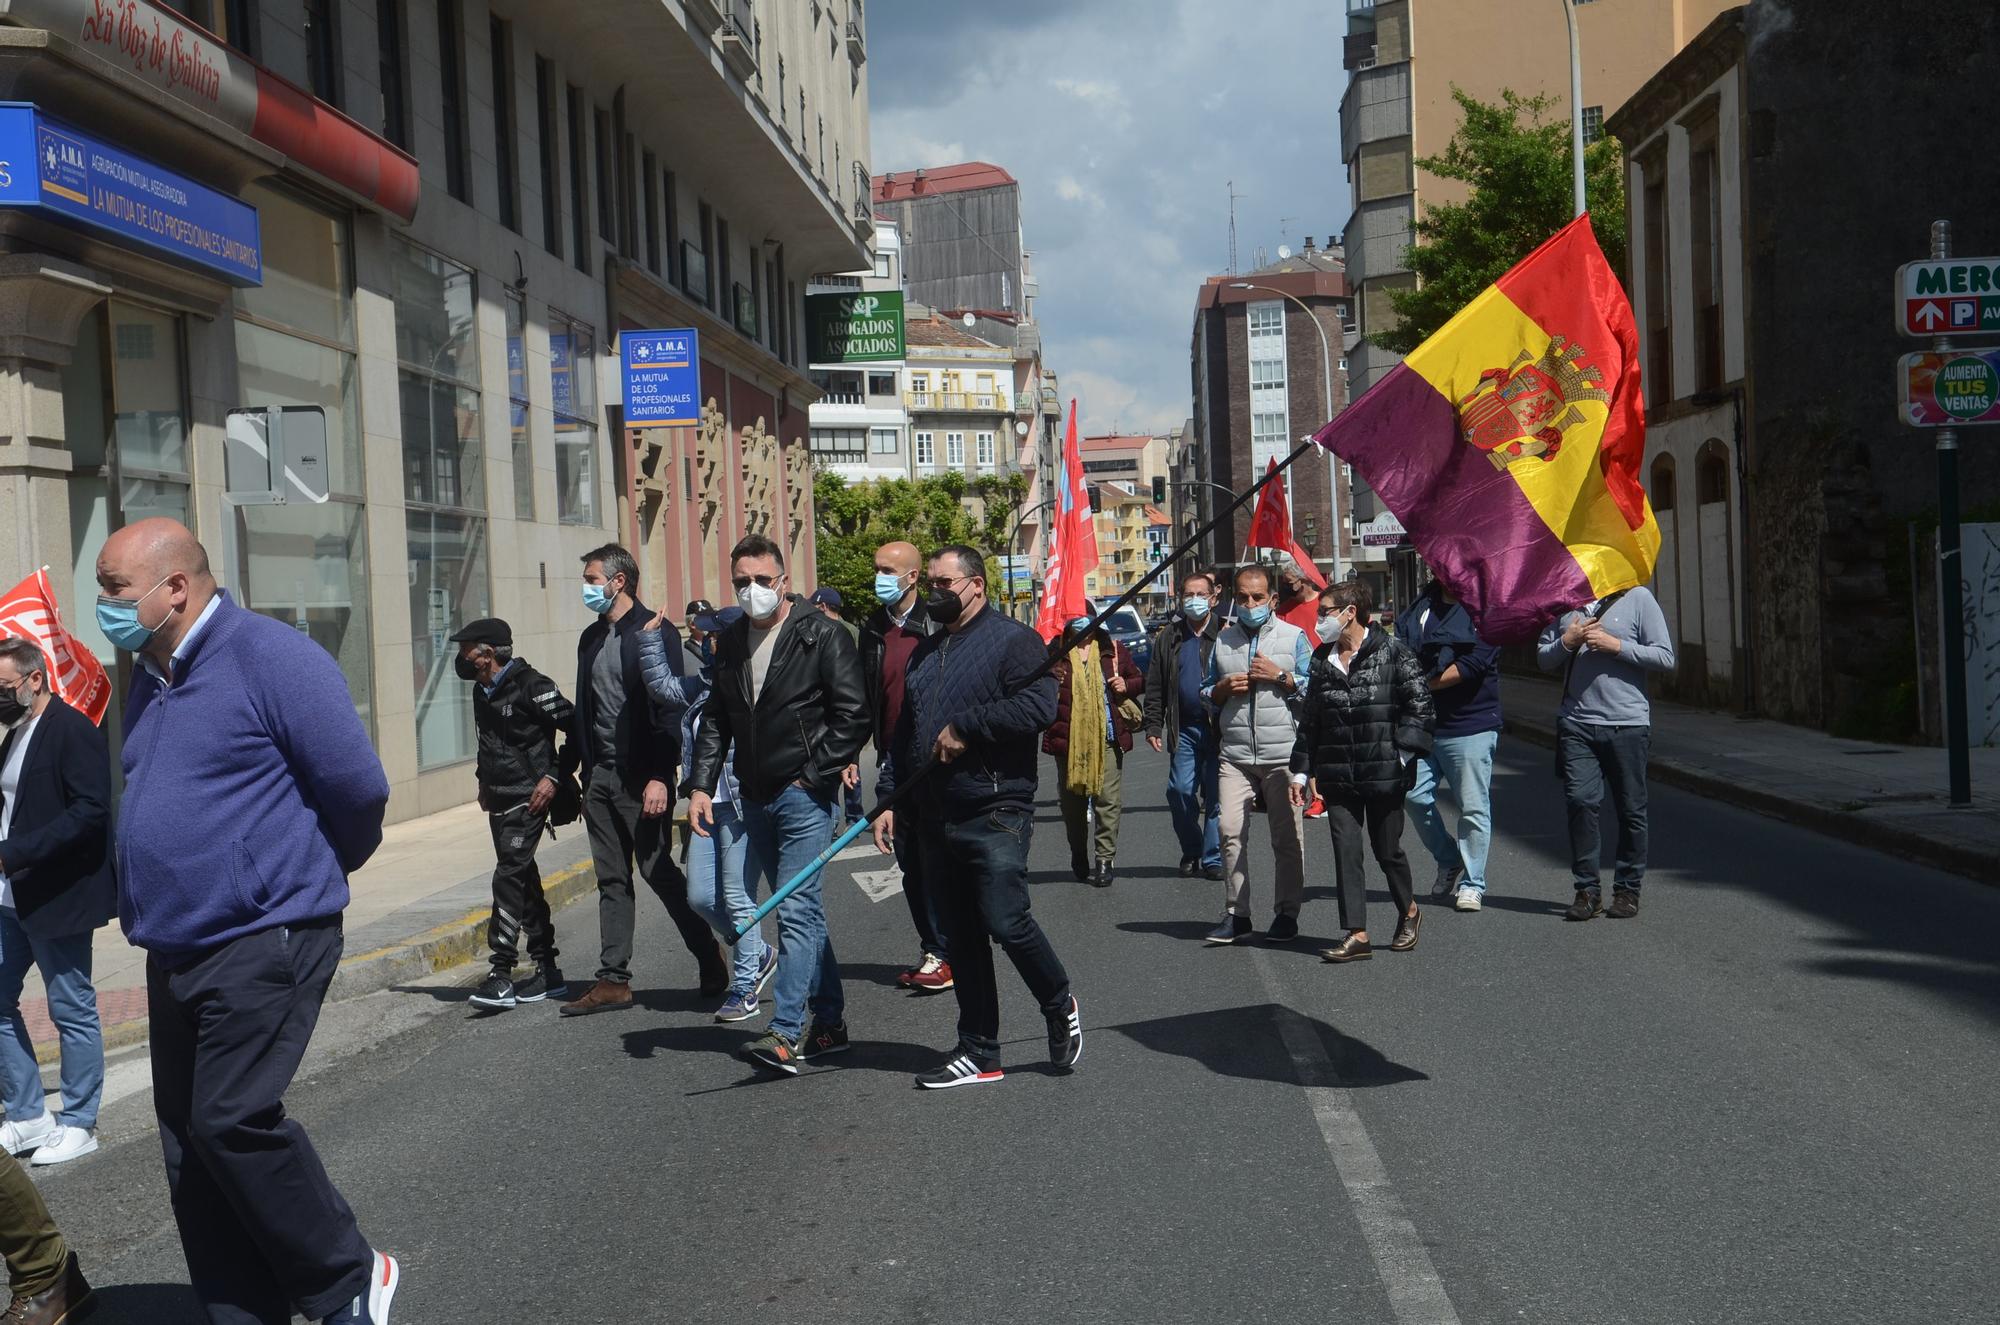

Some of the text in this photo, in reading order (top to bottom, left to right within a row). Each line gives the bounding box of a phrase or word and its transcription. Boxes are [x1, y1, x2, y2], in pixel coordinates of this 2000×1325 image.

[83, 0, 220, 103] La Voz de Galicia
[61, 143, 85, 169] A.M.A.
[91, 154, 128, 183] AGRUPACIÓN
[128, 169, 150, 192] MUTUAL
[150, 178, 188, 207] ASEGURADORA
[93, 185, 258, 270] LA MUTUA DE LOS PROFESIONALES SANITARIOS
[840, 296, 879, 318] S&P
[827, 320, 895, 336] ABOGADOS
[656, 341, 686, 351] A.M.A.
[826, 338, 897, 354] ASOCIADOS
[630, 373, 669, 382] LA MUTUA
[1944, 364, 1988, 380] AUMENTA
[631, 384, 658, 393] DE LOS
[1945, 380, 1986, 395] TUS
[632, 394, 691, 404] PROFESIONALES
[1944, 395, 1989, 410] VENTAS
[632, 405, 676, 416] SANITARIOS
